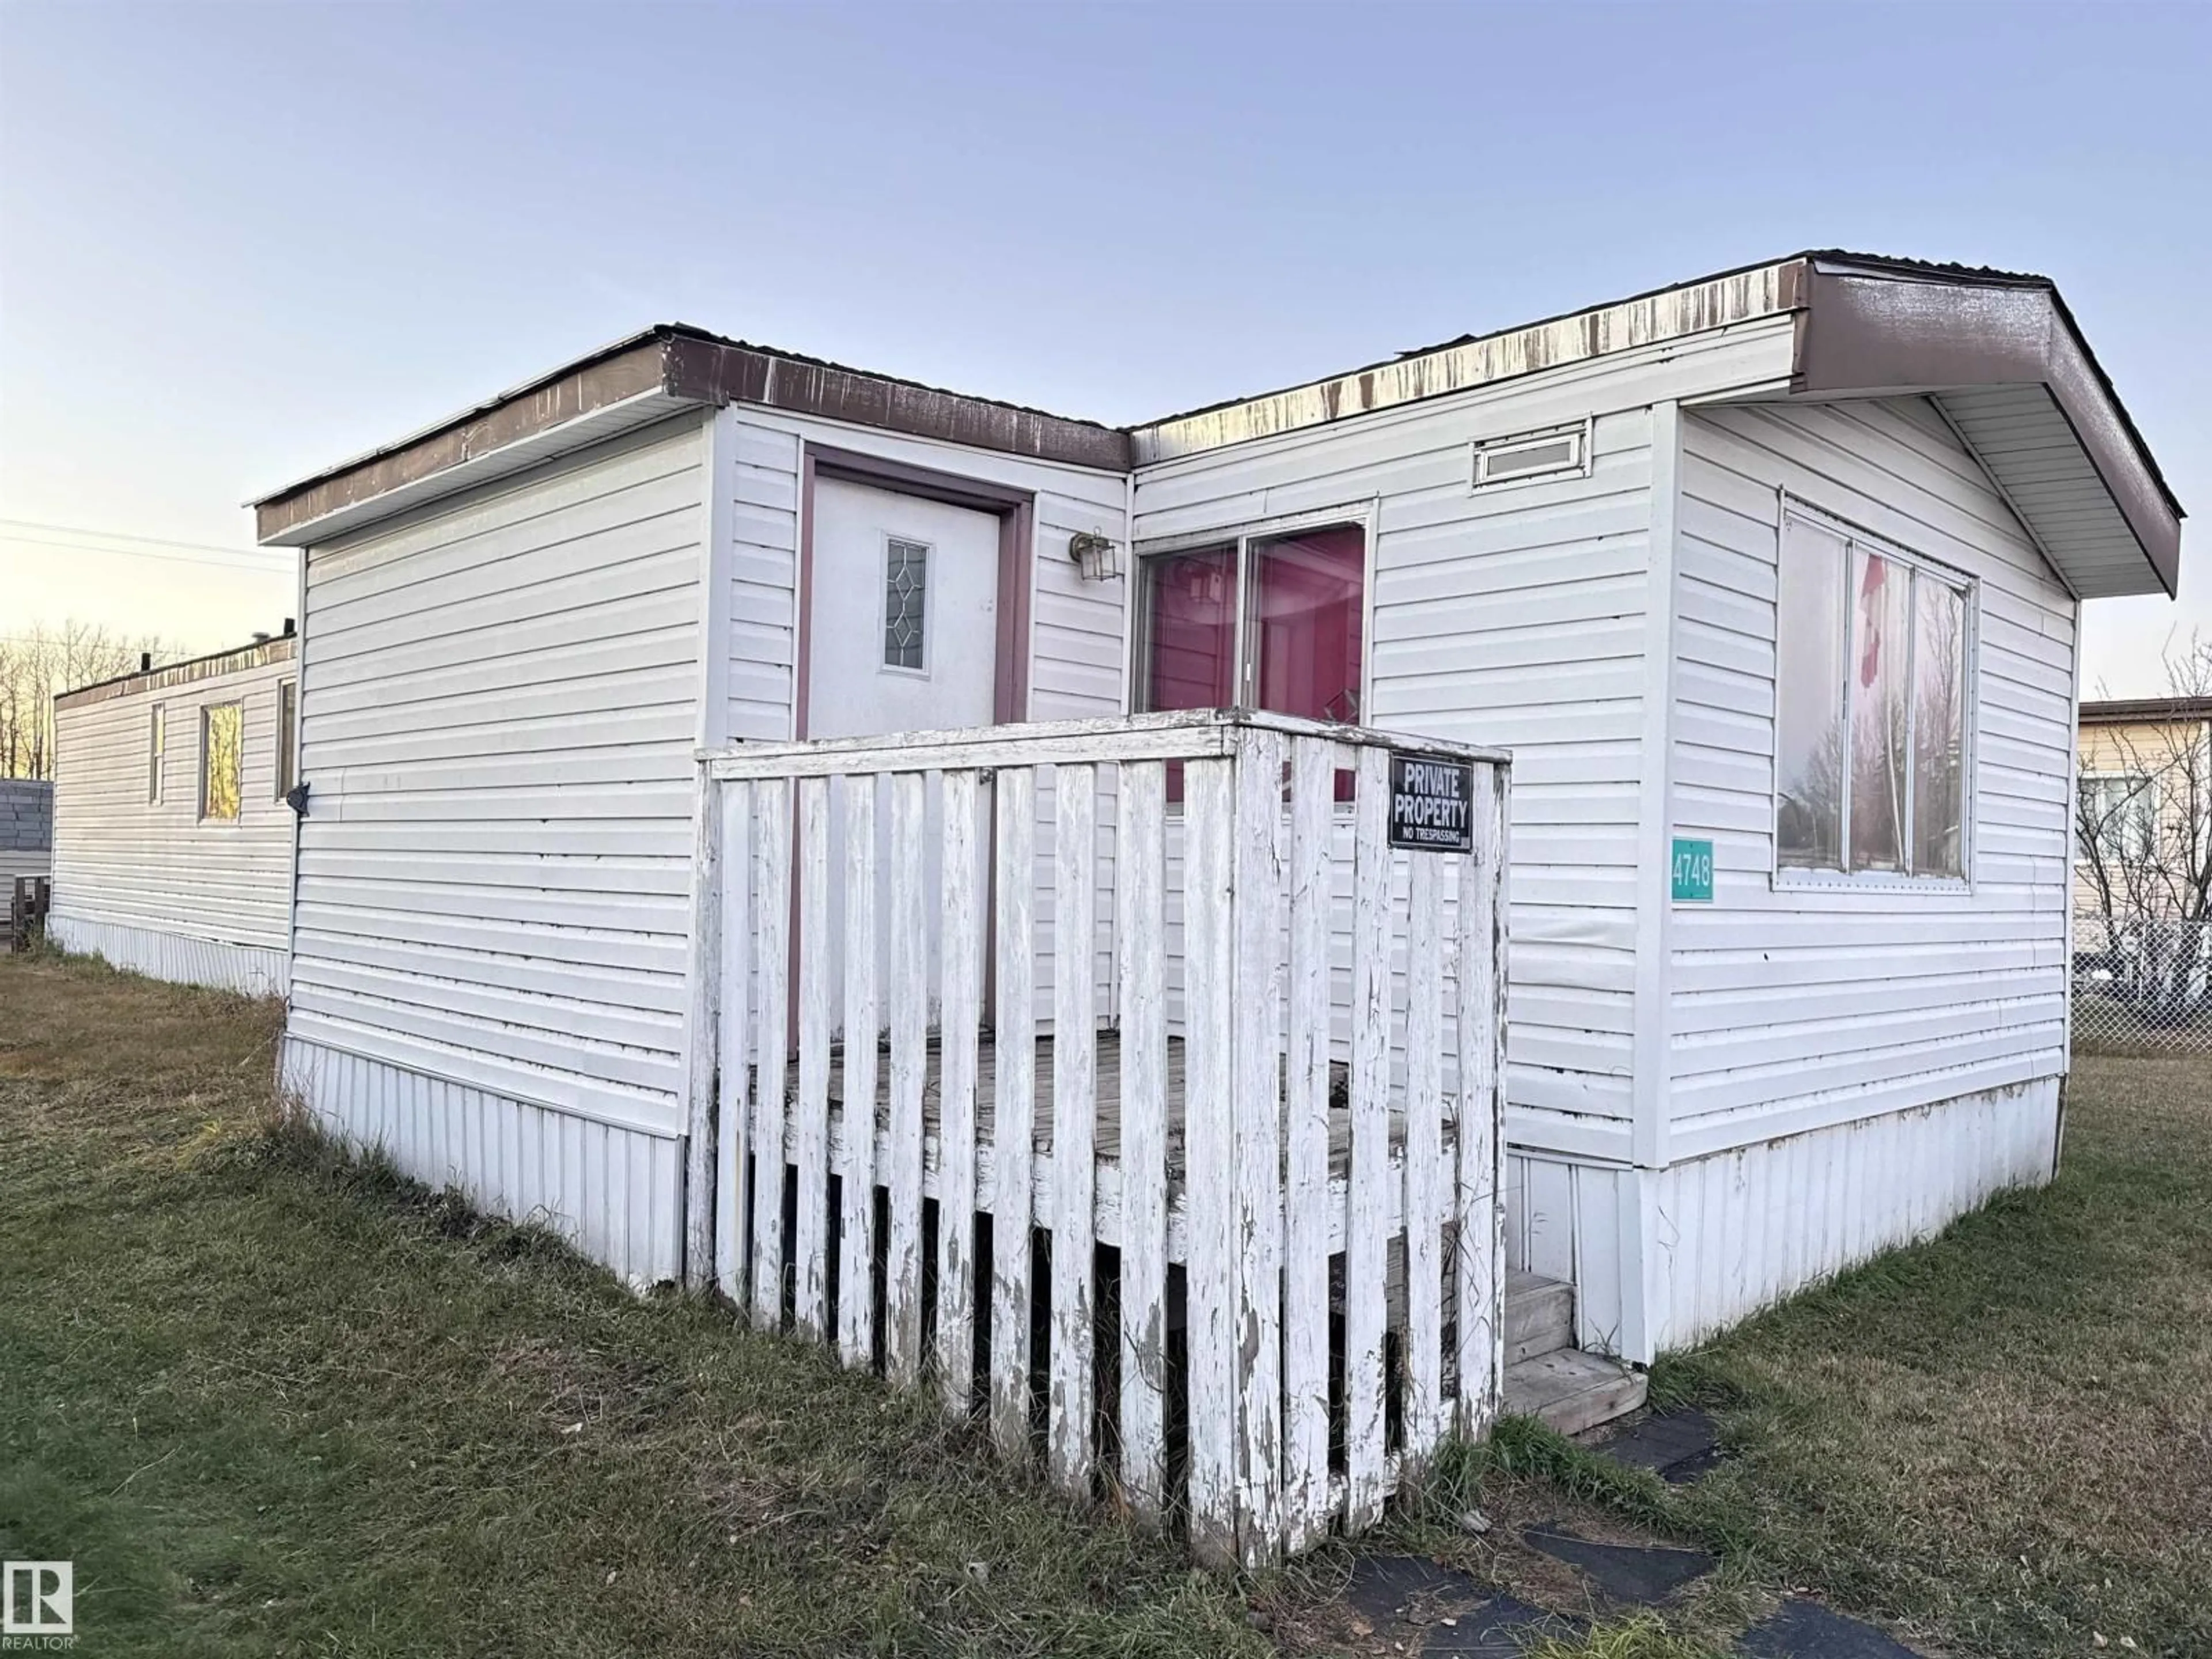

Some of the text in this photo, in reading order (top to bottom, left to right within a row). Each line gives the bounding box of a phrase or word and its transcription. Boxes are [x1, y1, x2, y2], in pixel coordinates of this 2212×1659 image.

[1404, 763, 1460, 798] PRIVATE
[1395, 793, 1467, 828] PROPERTY
[1403, 826, 1460, 842] NO TRESPASSING
[1673, 853, 1710, 886] 4748
